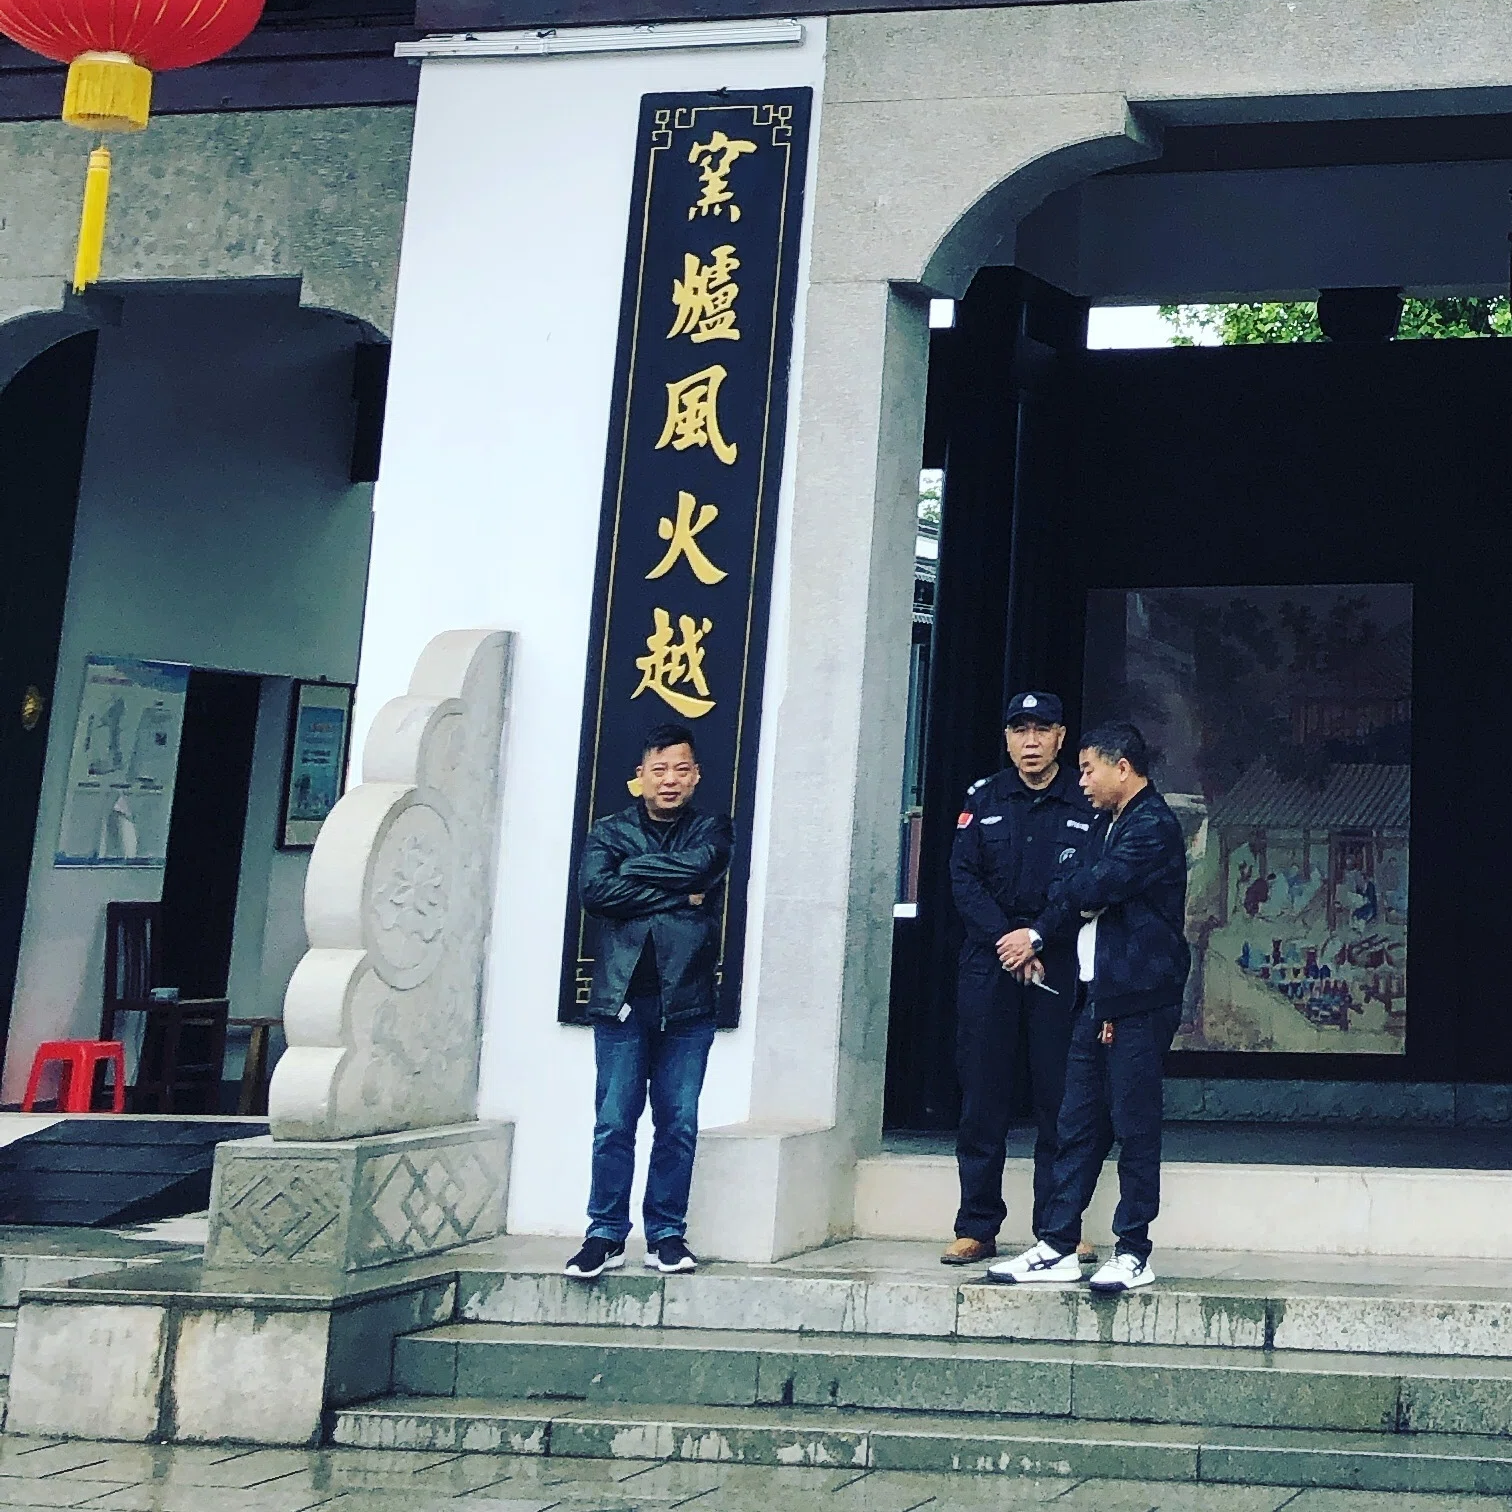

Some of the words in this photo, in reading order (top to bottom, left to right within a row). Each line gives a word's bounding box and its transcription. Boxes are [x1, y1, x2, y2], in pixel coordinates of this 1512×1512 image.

[626, 131, 758, 800] 窯爐風火越
